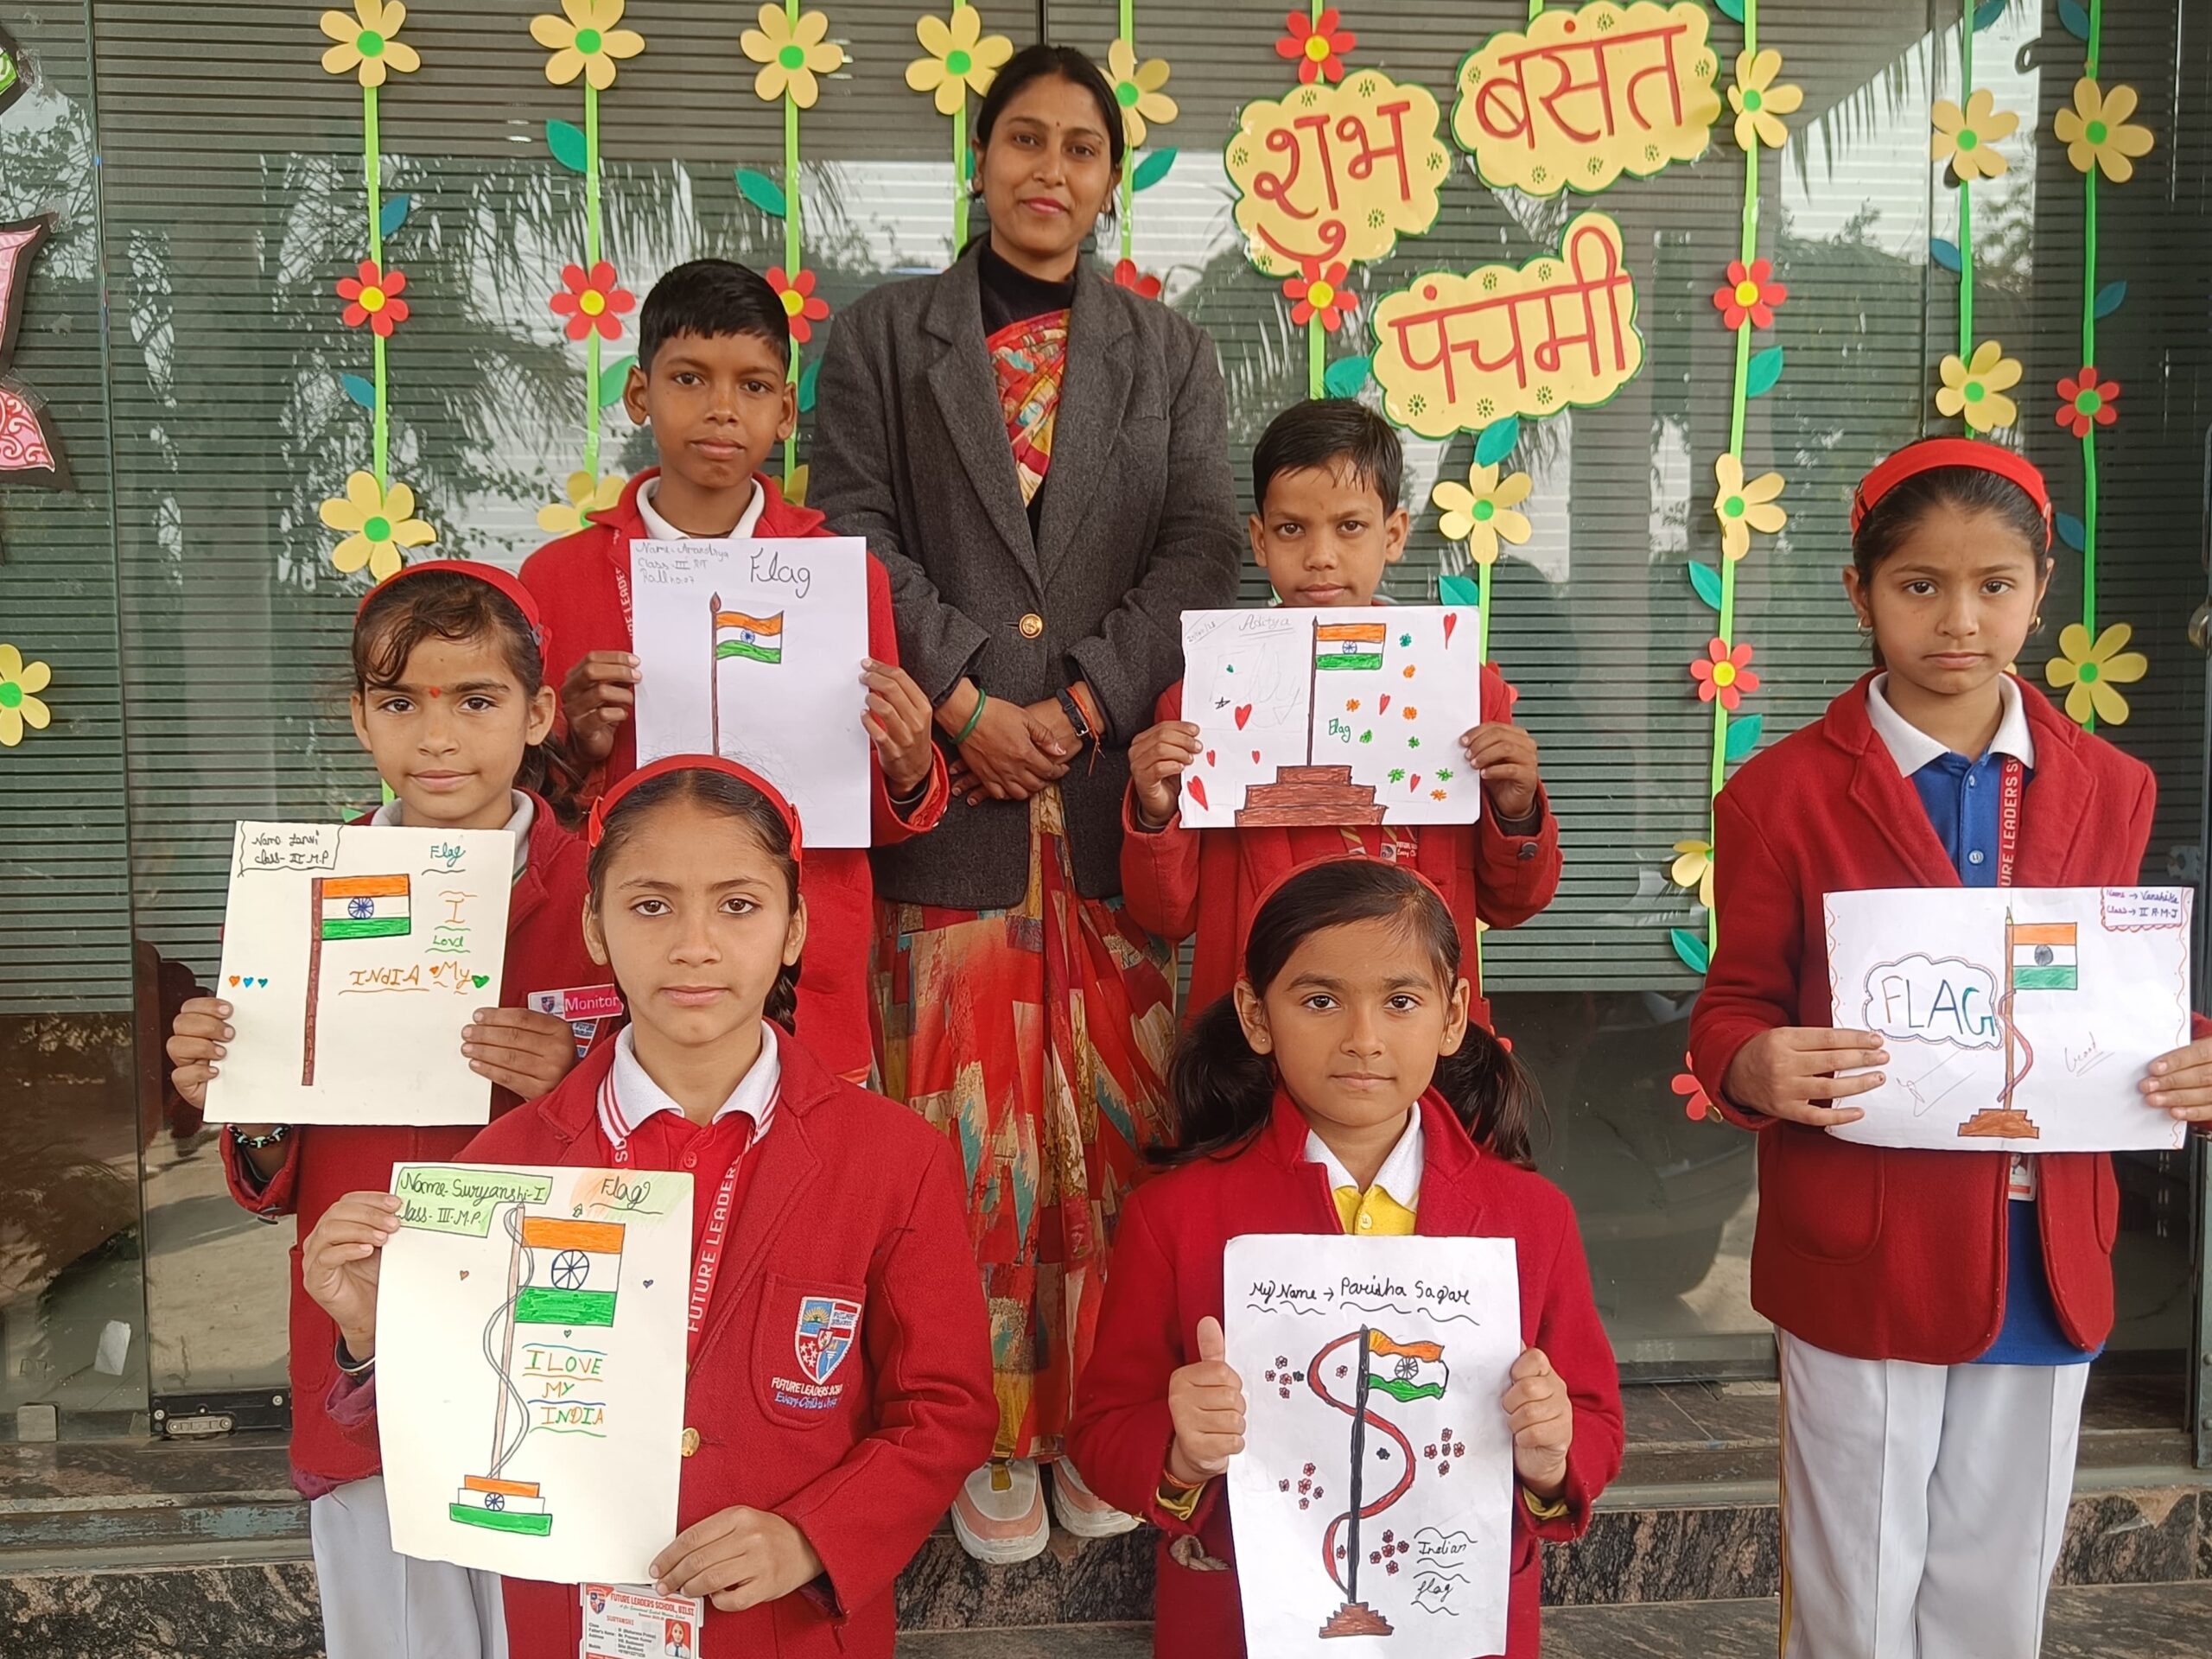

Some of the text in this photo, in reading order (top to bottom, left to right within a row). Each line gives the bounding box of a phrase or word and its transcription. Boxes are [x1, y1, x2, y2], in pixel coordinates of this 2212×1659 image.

[1388, 226, 1630, 404] पंचमी
[750, 546, 811, 599] Flag
[1238, 613, 1291, 632] Aditya
[2003, 776, 2018, 849] LEADERS
[444, 898, 466, 924] I
[564, 995, 620, 1013] Monitor
[1881, 976, 1996, 1037] FLAG
[601, 1175, 652, 1210] Flag
[687, 1250, 717, 1332] FUTURE
[1275, 1283, 1318, 1300] Name
[524, 1349, 603, 1375] I LOVE
[542, 1381, 575, 1399] MY
[540, 1406, 604, 1426] INDIA
[1417, 1539, 1467, 1555] Indian
[610, 1593, 631, 1605] FUTURE
[631, 1597, 655, 1609] LEADERS
